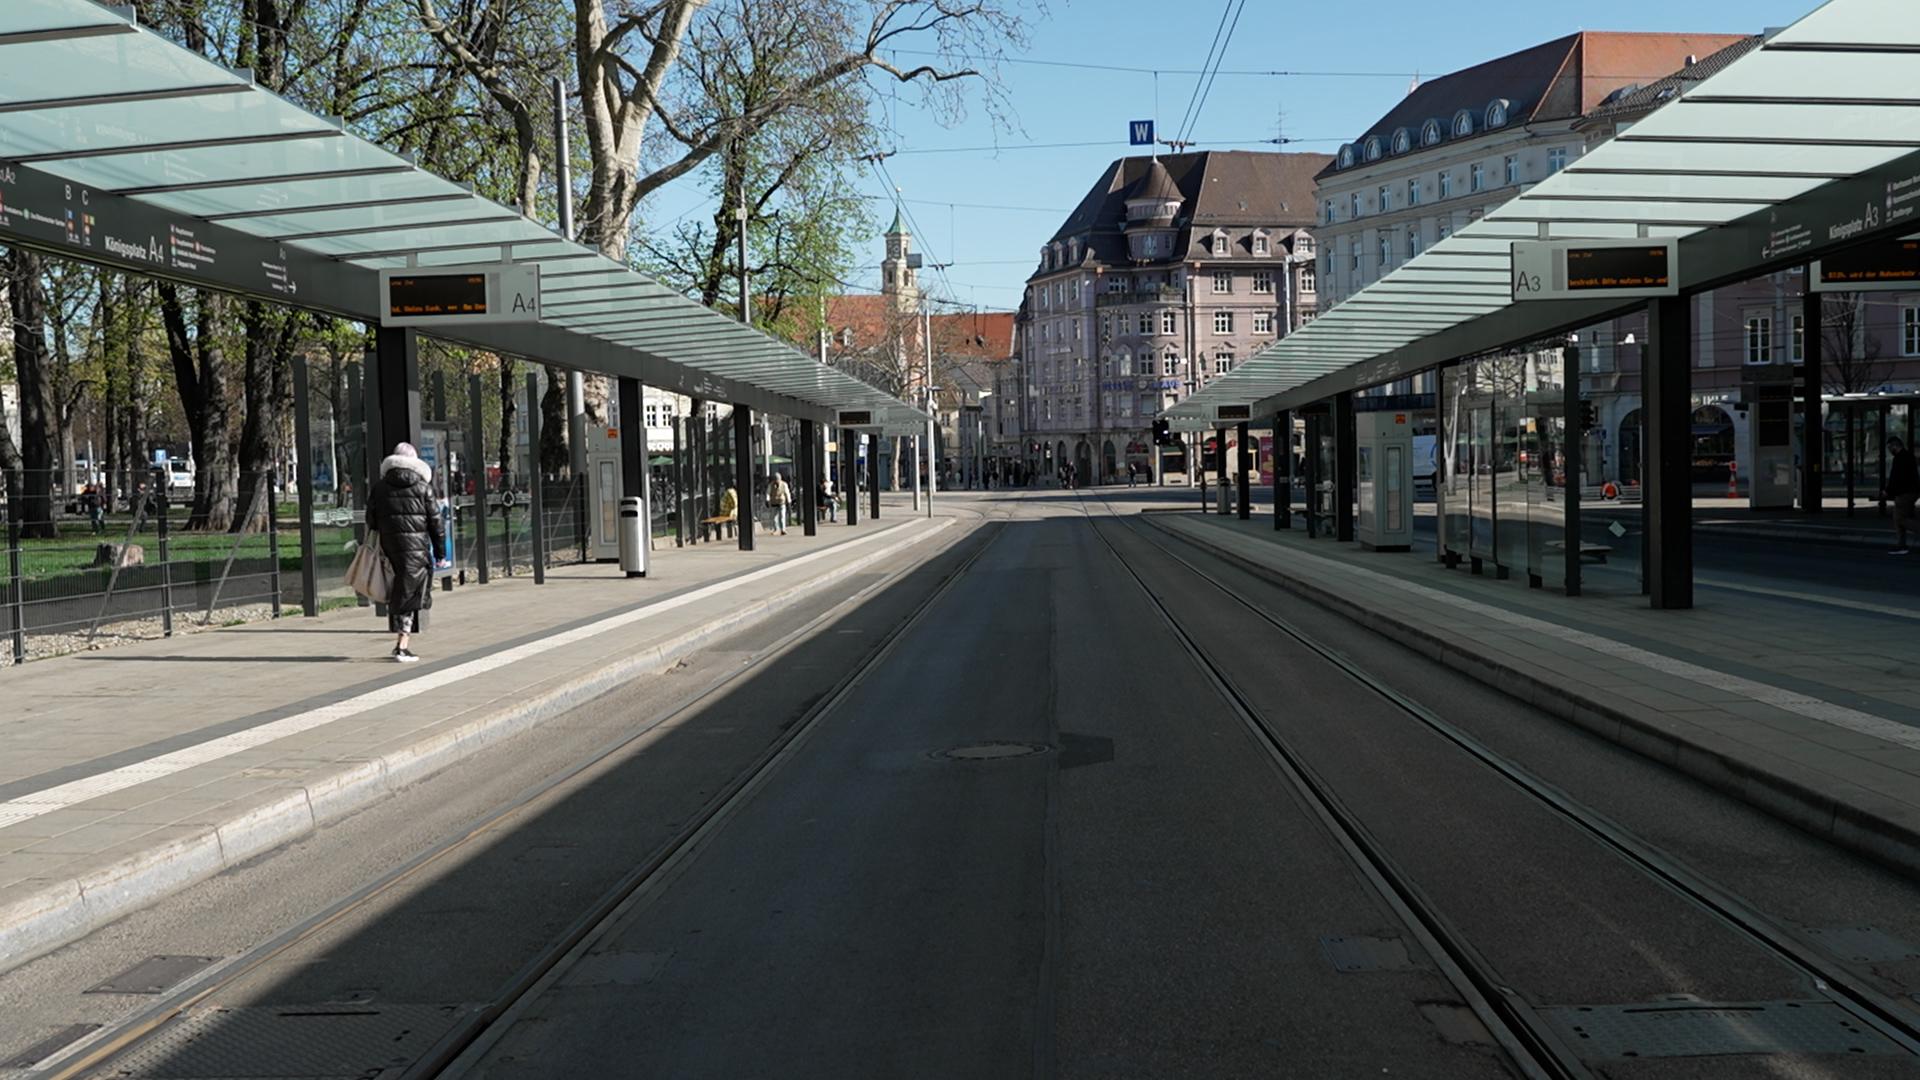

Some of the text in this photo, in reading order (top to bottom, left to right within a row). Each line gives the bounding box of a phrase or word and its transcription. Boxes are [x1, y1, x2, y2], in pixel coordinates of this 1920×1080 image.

[1135, 123, 1148, 141] W
[65, 184, 89, 205] B C
[1829, 219, 1863, 239] Königsplatz
[1864, 202, 1879, 229] A3
[104, 235, 146, 260] Königsplatz
[149, 236, 164, 264] A4
[1516, 271, 1541, 292] A3
[512, 293, 536, 312] A4
